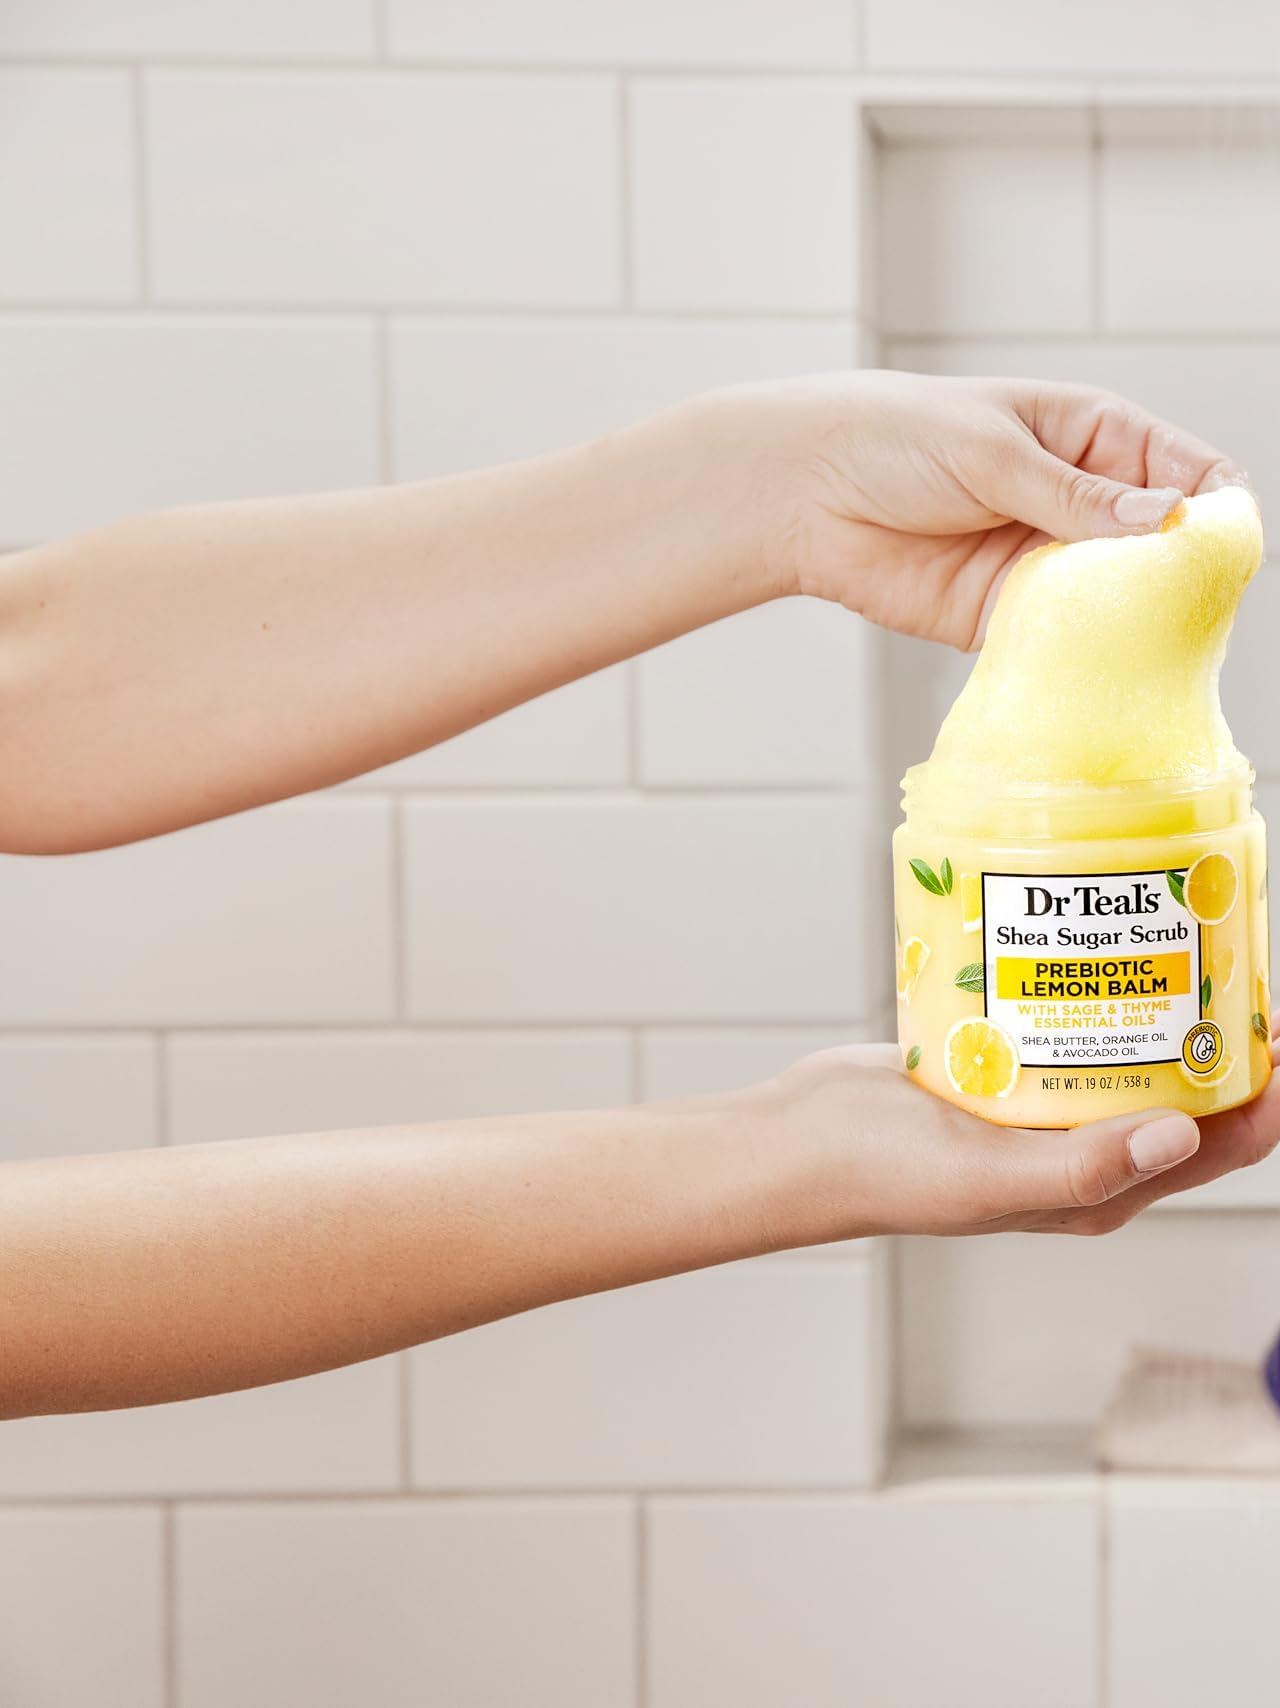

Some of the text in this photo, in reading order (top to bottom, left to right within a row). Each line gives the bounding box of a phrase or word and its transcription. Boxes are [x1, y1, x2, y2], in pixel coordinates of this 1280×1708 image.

[1024, 883, 1161, 916] Dr Teal's
[997, 922, 1188, 949] Shea Sugar Scrub
[1036, 960, 1153, 978] PREBIOTIC
[1022, 977, 1167, 997] LEMON BALM
[1017, 1000, 1171, 1015] WITH SAGE & THYME
[1035, 1015, 1155, 1029] ESSENTIAL OILS
[1022, 1033, 1168, 1046] SHEA BUTTER, ORANGE OIL
[1188, 1025, 1217, 1041] PREBIOTIC
[1052, 1047, 1139, 1058] & AVOCADO OIL
[1042, 1076, 1150, 1090] NET WT. 19 OZ / 538 g
